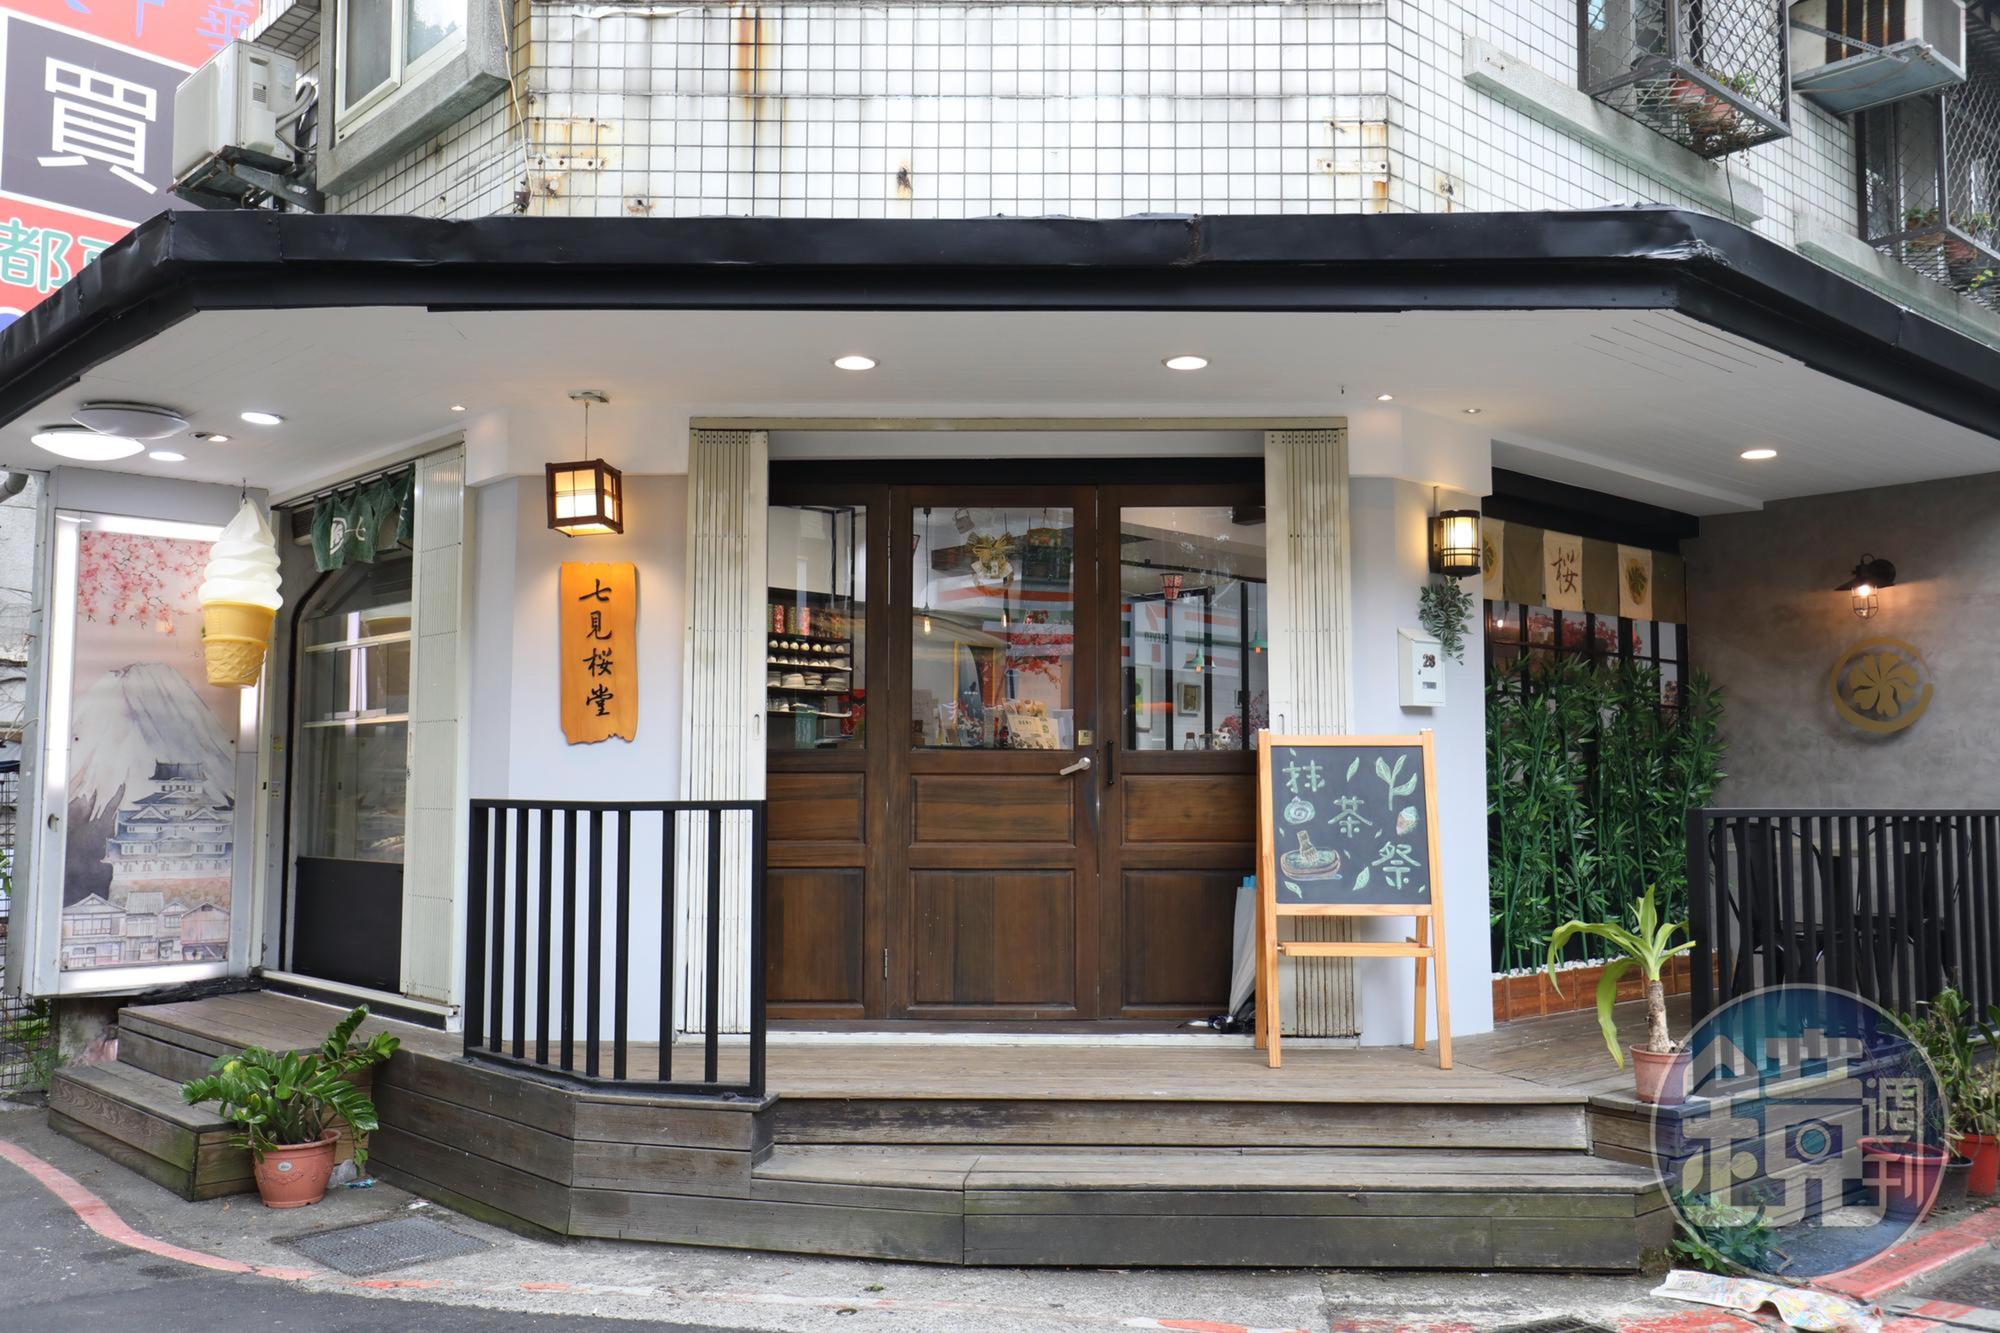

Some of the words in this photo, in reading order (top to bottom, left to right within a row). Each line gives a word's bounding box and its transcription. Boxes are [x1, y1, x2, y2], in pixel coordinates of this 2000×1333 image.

[37, 56, 158, 195] 買
[579, 578, 614, 717] 七見桜堂
